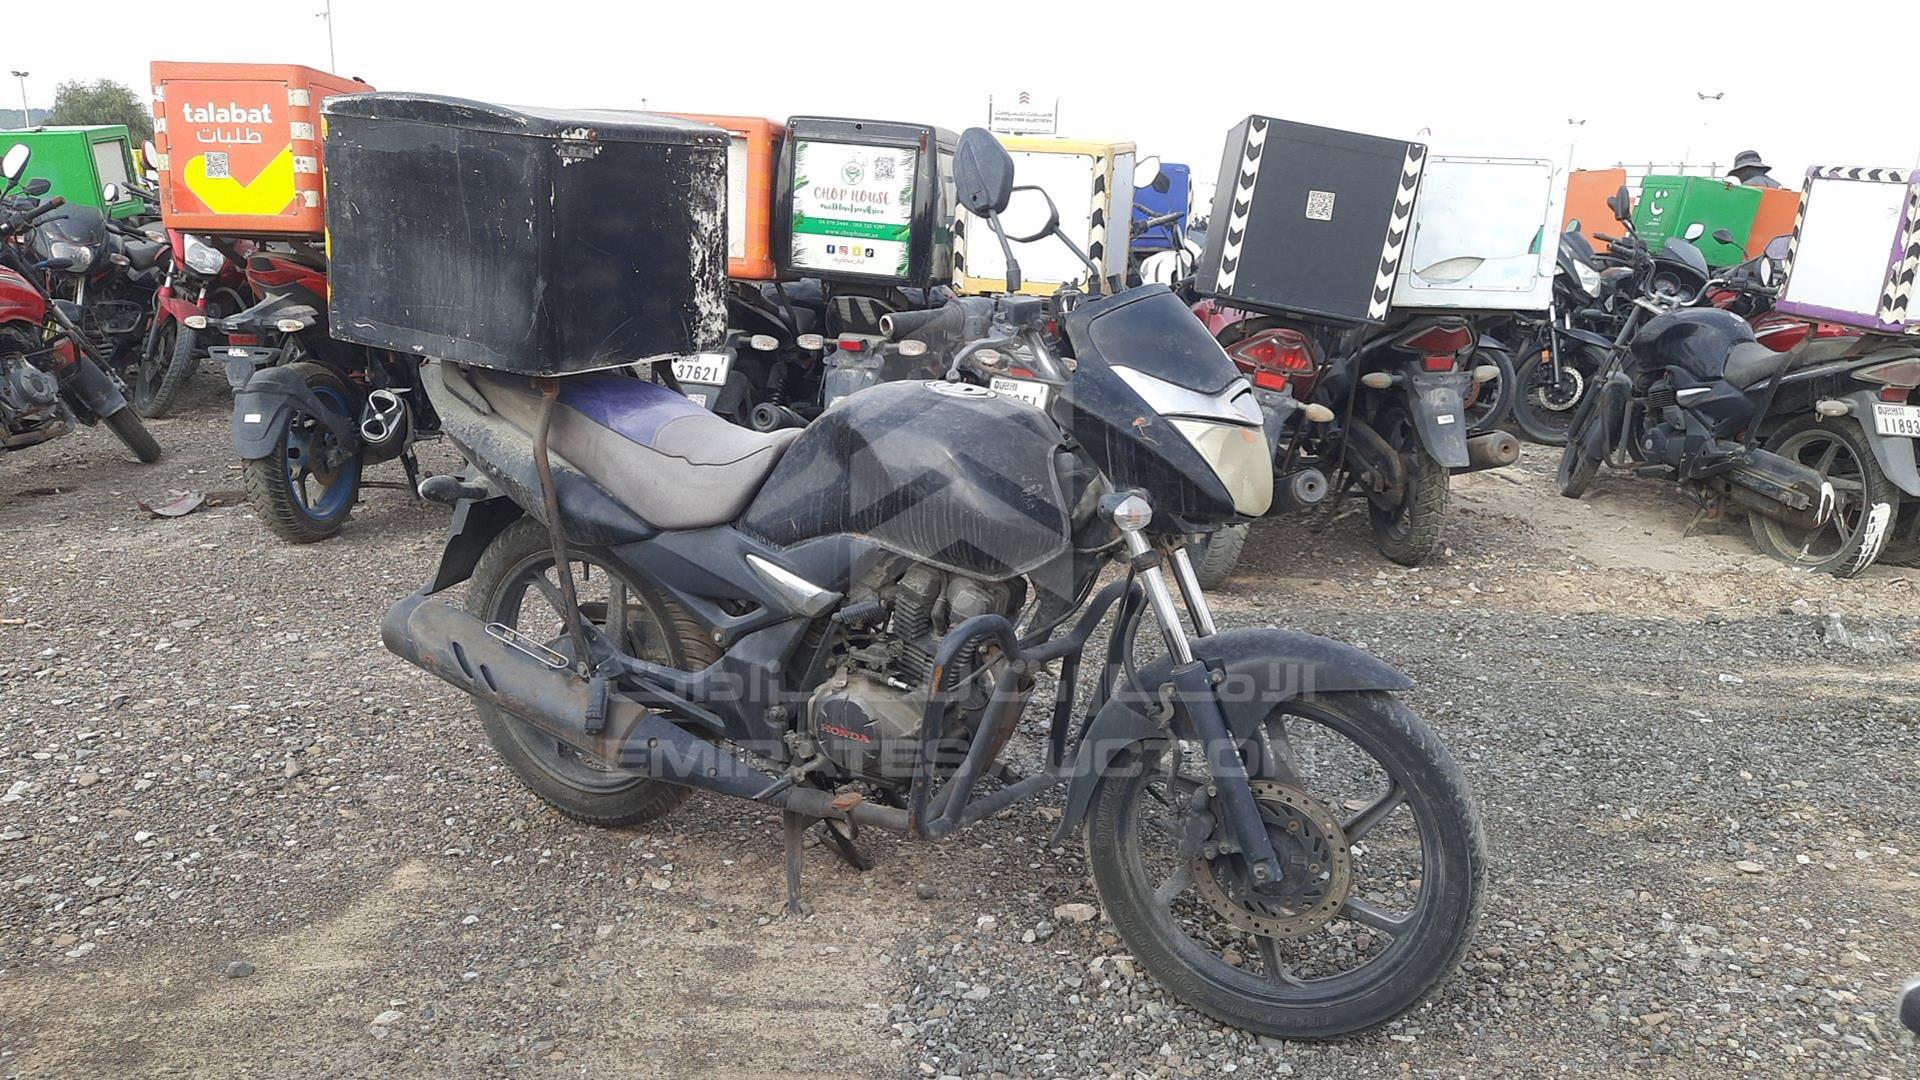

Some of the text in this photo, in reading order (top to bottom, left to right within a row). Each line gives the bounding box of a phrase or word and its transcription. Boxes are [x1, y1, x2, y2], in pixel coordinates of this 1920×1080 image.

[183, 102, 272, 123] talabat
[196, 127, 262, 148] طلبات
[814, 187, 890, 205] CHOP HOUSE
[676, 364, 718, 381] 37621
[1884, 417, 1920, 434] 11893
[820, 722, 872, 744] HONDA
